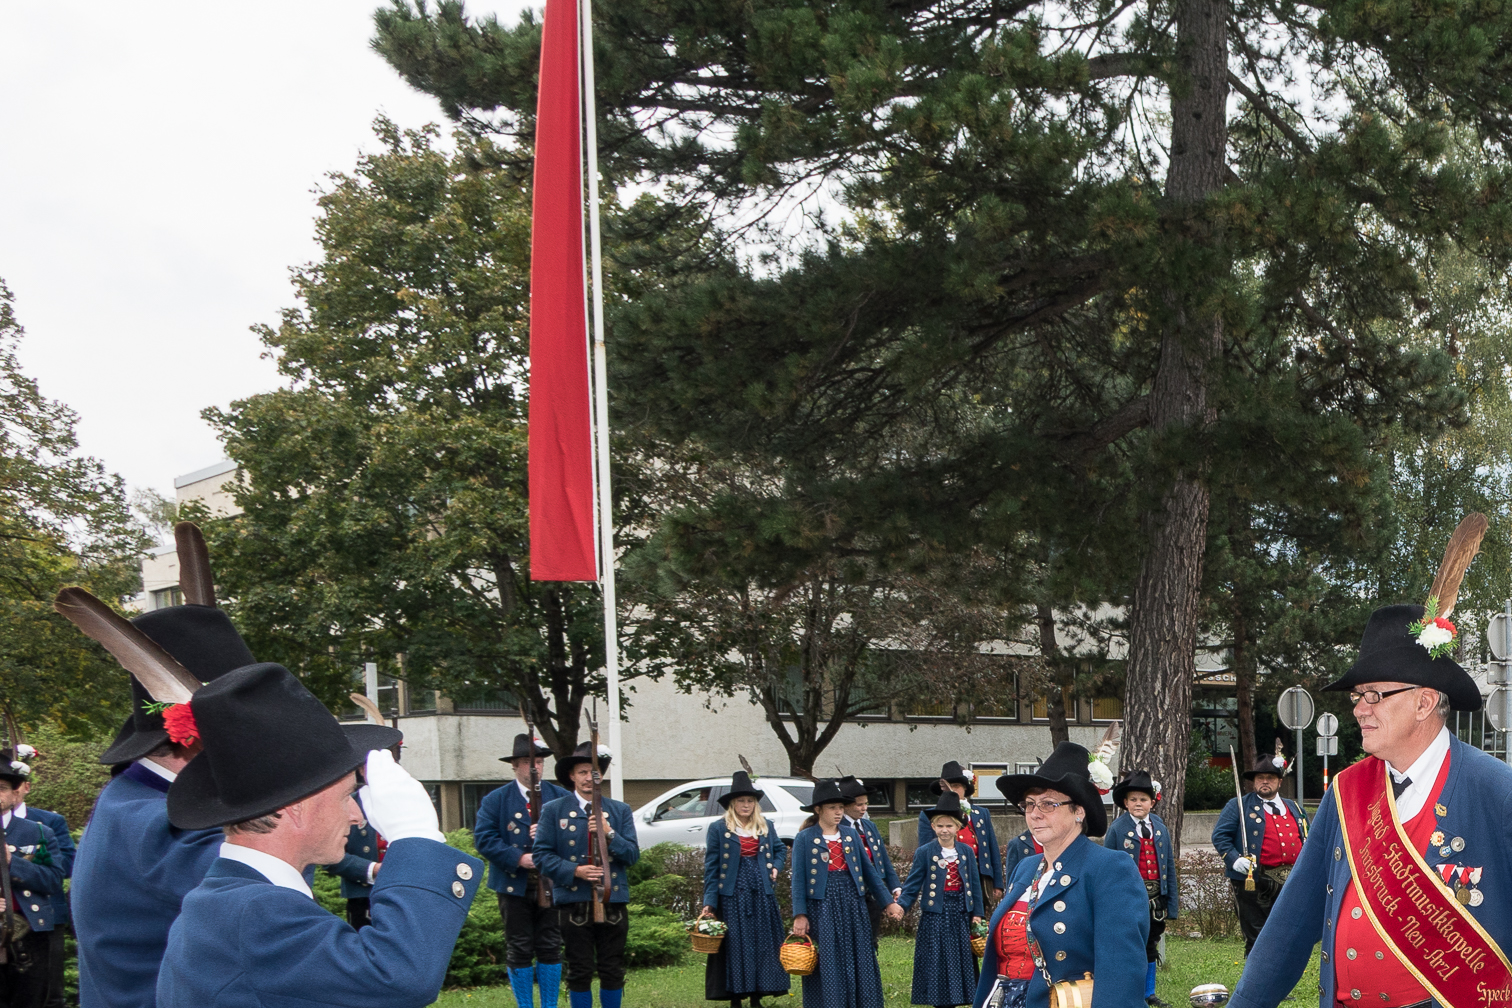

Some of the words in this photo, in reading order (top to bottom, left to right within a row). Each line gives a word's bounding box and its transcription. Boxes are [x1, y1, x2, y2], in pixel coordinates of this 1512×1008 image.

[1359, 837, 1402, 917] Innsbruck
[1400, 915, 1426, 949] Neu
[1424, 949, 1460, 982] Arzl
[1367, 790, 1390, 840] Jugend
[1383, 842, 1487, 975] Stadtmusikkapelle
